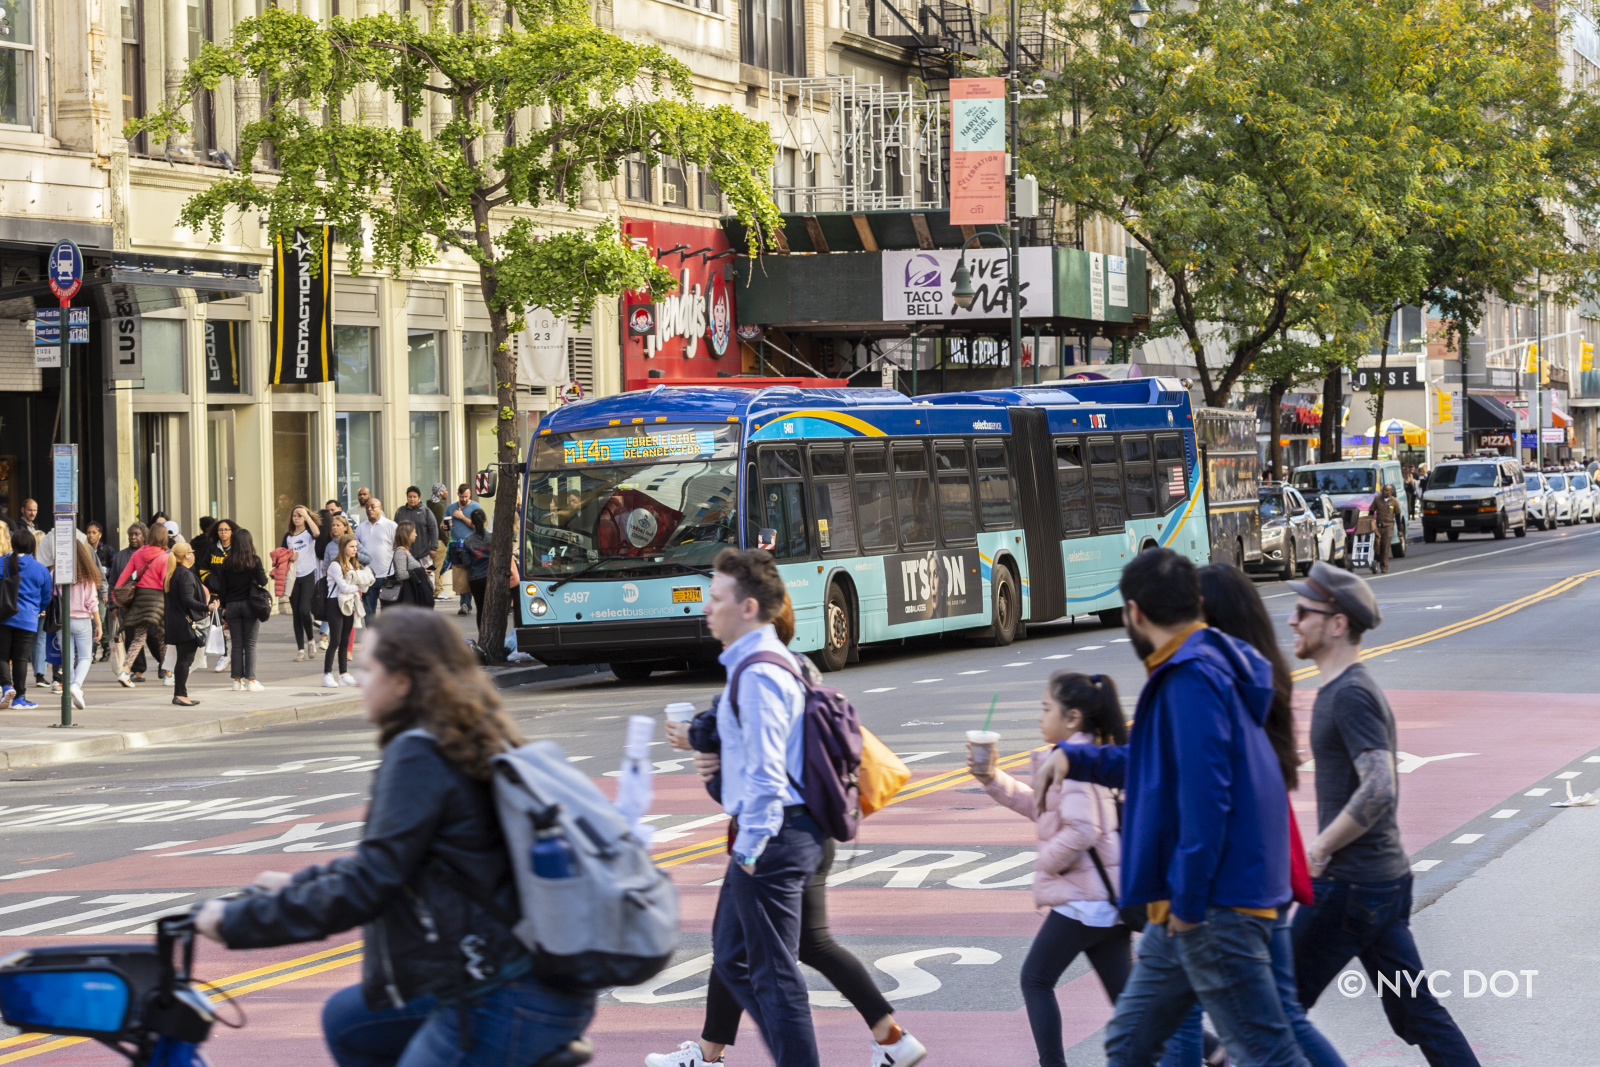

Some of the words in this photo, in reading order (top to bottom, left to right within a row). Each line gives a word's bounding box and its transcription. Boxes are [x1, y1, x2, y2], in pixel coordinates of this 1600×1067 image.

[960, 106, 989, 136] HARVEST
[972, 116, 998, 144] SQUARE
[957, 155, 998, 187] CELEBRATION
[970, 204, 984, 214] citi
[51, 282, 58, 291] NO
[56, 282, 78, 297] STANDING
[904, 291, 943, 303] TACO
[907, 304, 943, 316] BELL
[70, 311, 87, 323] M14A
[296, 261, 311, 379] FOOTACTION
[70, 328, 88, 341] M14D
[784, 422, 794, 434] 5497
[626, 436, 659, 448] LOWER
[661, 435, 668, 446] E
[670, 433, 696, 444] SIDE
[1481, 436, 1512, 446] PIZZA
[564, 439, 610, 464] M14D
[624, 445, 701, 458] DELANCEY-FDR
[901, 558, 930, 602] IT'S
[564, 592, 590, 604] 5497
[590, 606, 674, 618] +selectbusservice
